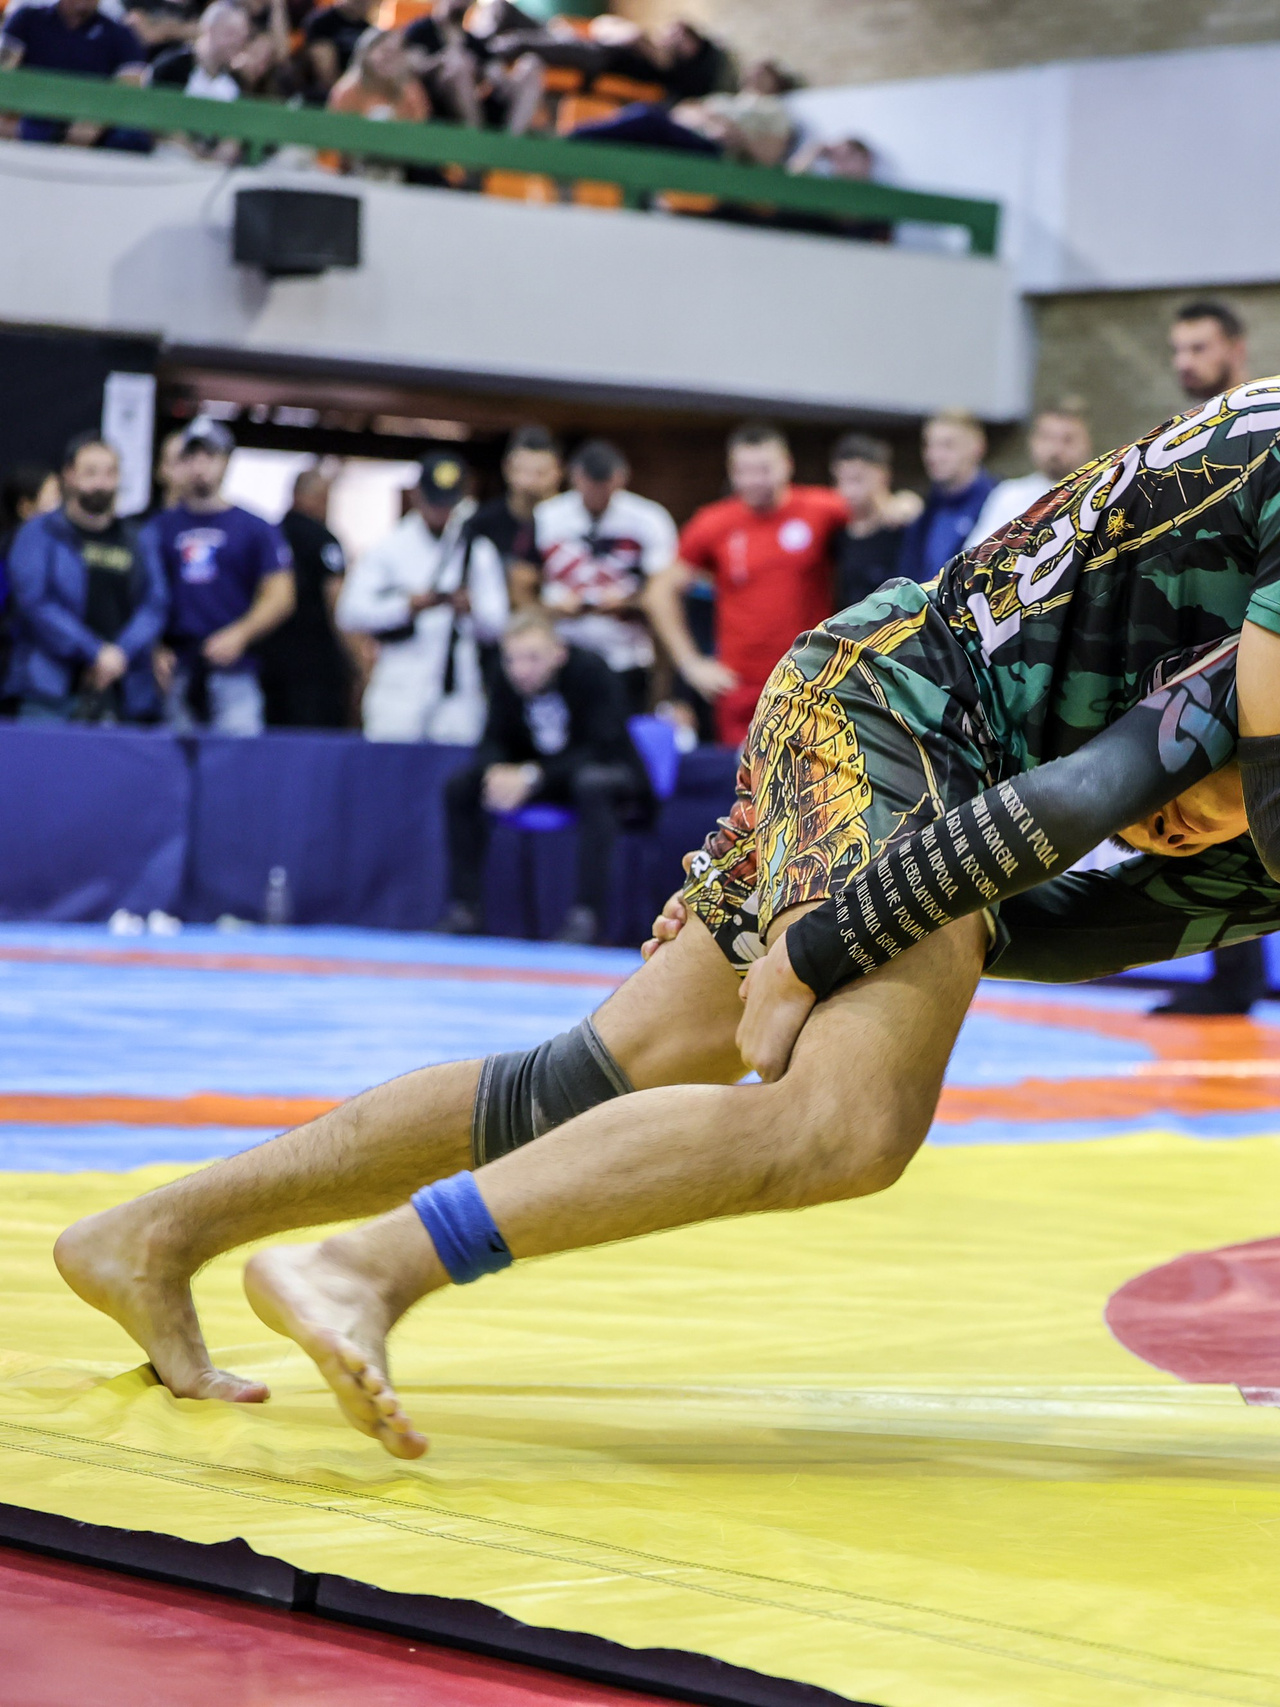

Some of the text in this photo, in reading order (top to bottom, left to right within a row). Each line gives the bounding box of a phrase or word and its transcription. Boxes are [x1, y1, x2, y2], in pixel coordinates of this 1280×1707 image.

[952, 834, 970, 857] НА
[884, 886, 901, 907] НЕ
[837, 904, 850, 923] МУ
[840, 928, 855, 943] ЈЕ
